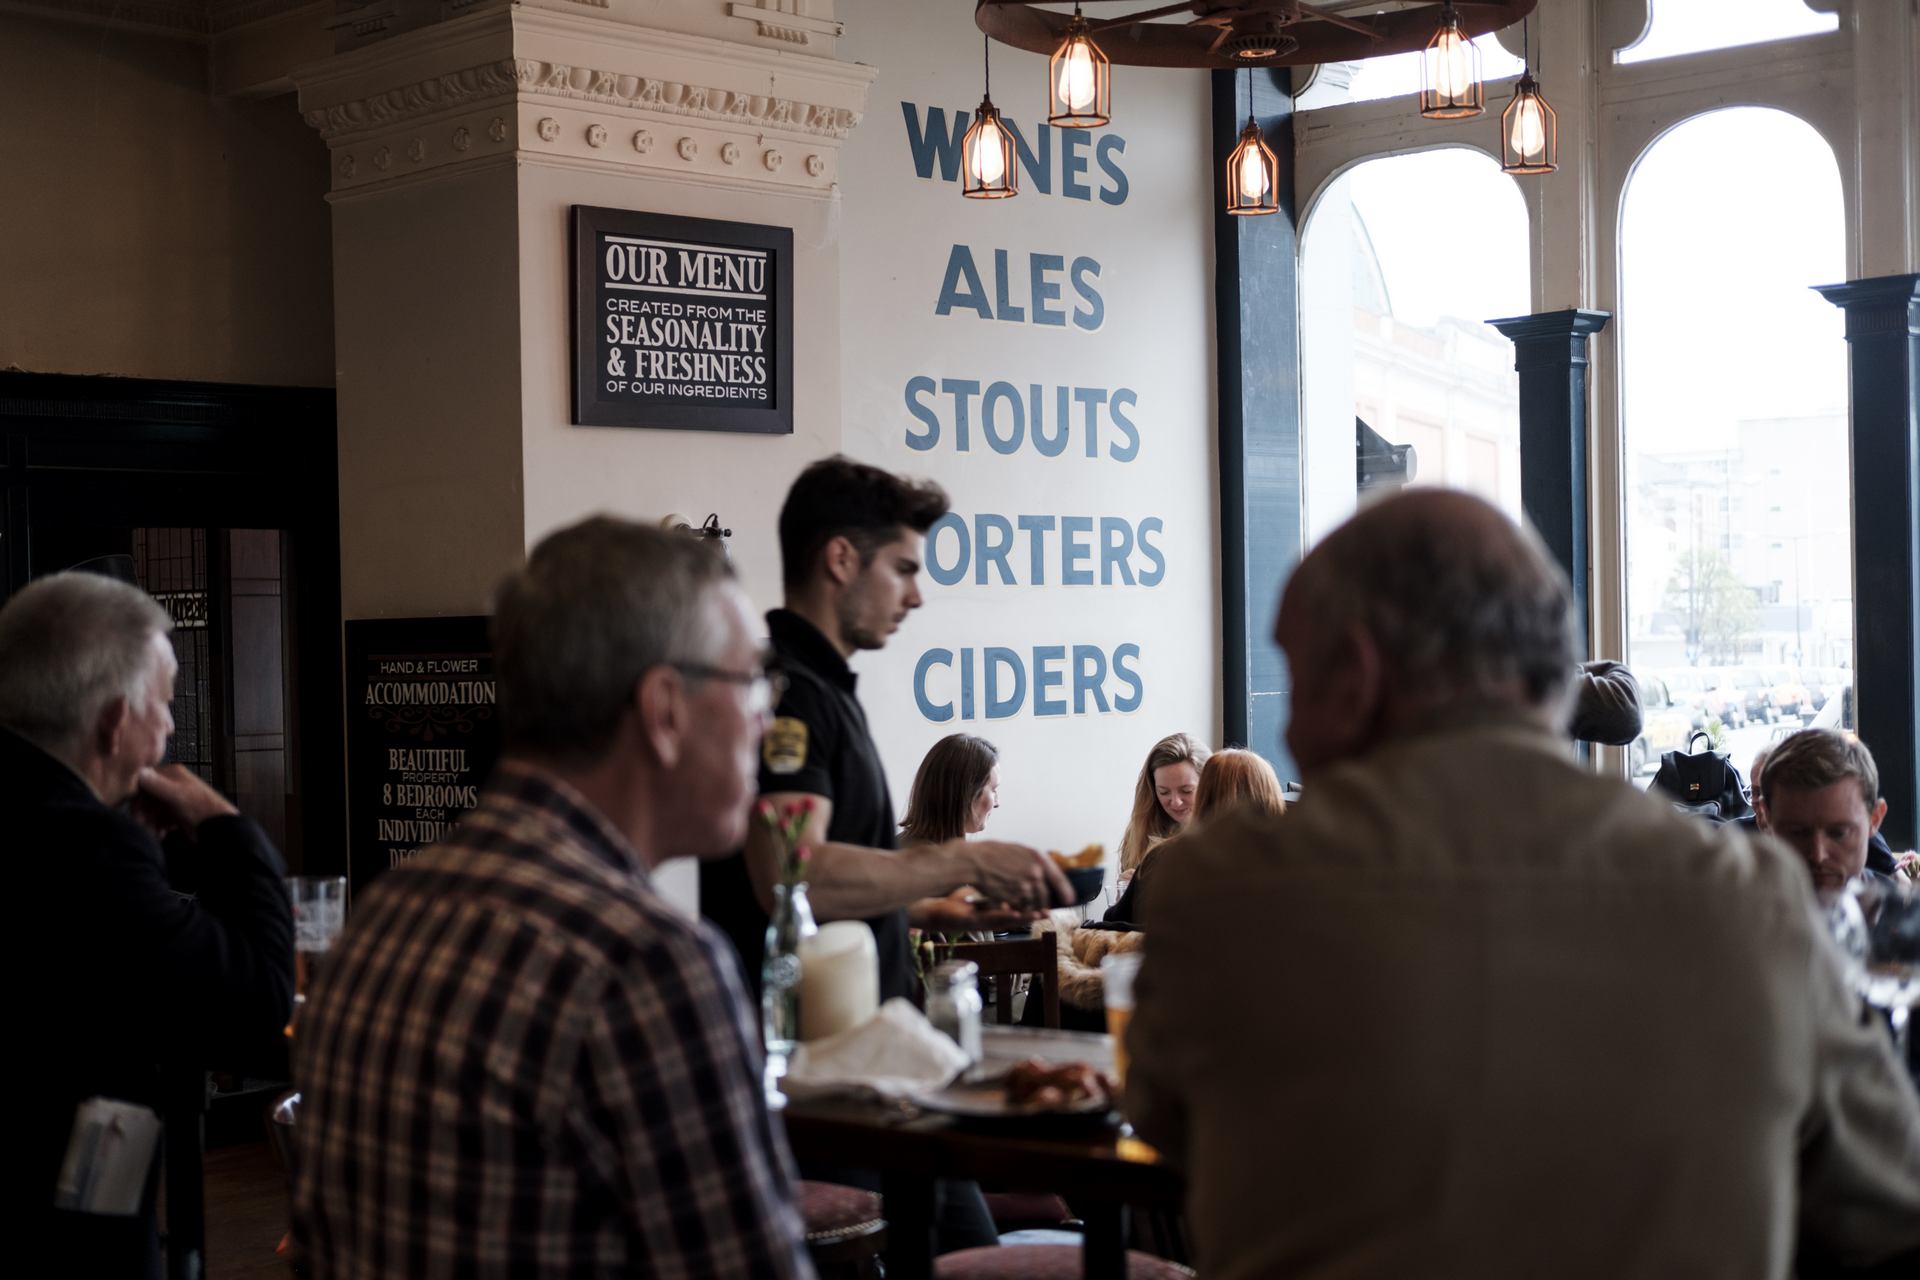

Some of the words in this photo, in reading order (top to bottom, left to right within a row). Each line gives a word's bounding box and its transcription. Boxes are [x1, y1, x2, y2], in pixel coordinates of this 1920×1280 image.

[900, 100, 1129, 206] WNES
[605, 244, 669, 285] OUR
[678, 251, 767, 293] MENU
[935, 244, 1105, 331] ALES
[606, 298, 683, 316] CREATED
[686, 304, 733, 320] FROM
[735, 308, 767, 323] THE
[606, 314, 767, 353] SEASONALITY
[606, 347, 626, 377] &
[634, 349, 767, 385] FRESHNESS
[606, 380, 628, 393] OF
[631, 382, 665, 396] OUR
[667, 384, 767, 400] INGREDIENTS
[904, 375, 1141, 463] STOUTS
[925, 511, 1166, 588] ORTERS
[380, 661, 414, 674] HAND
[416, 663, 425, 674] &
[427, 660, 478, 673] FLOWER
[913, 642, 1143, 723] CIDERS
[365, 681, 496, 705] ACCOMMODATION
[388, 749, 470, 771] BEAUTIFUL
[402, 773, 459, 783] PROPERTY
[383, 783, 393, 806] 8
[397, 784, 478, 808] BEDROOMS
[416, 808, 445, 820] EACH
